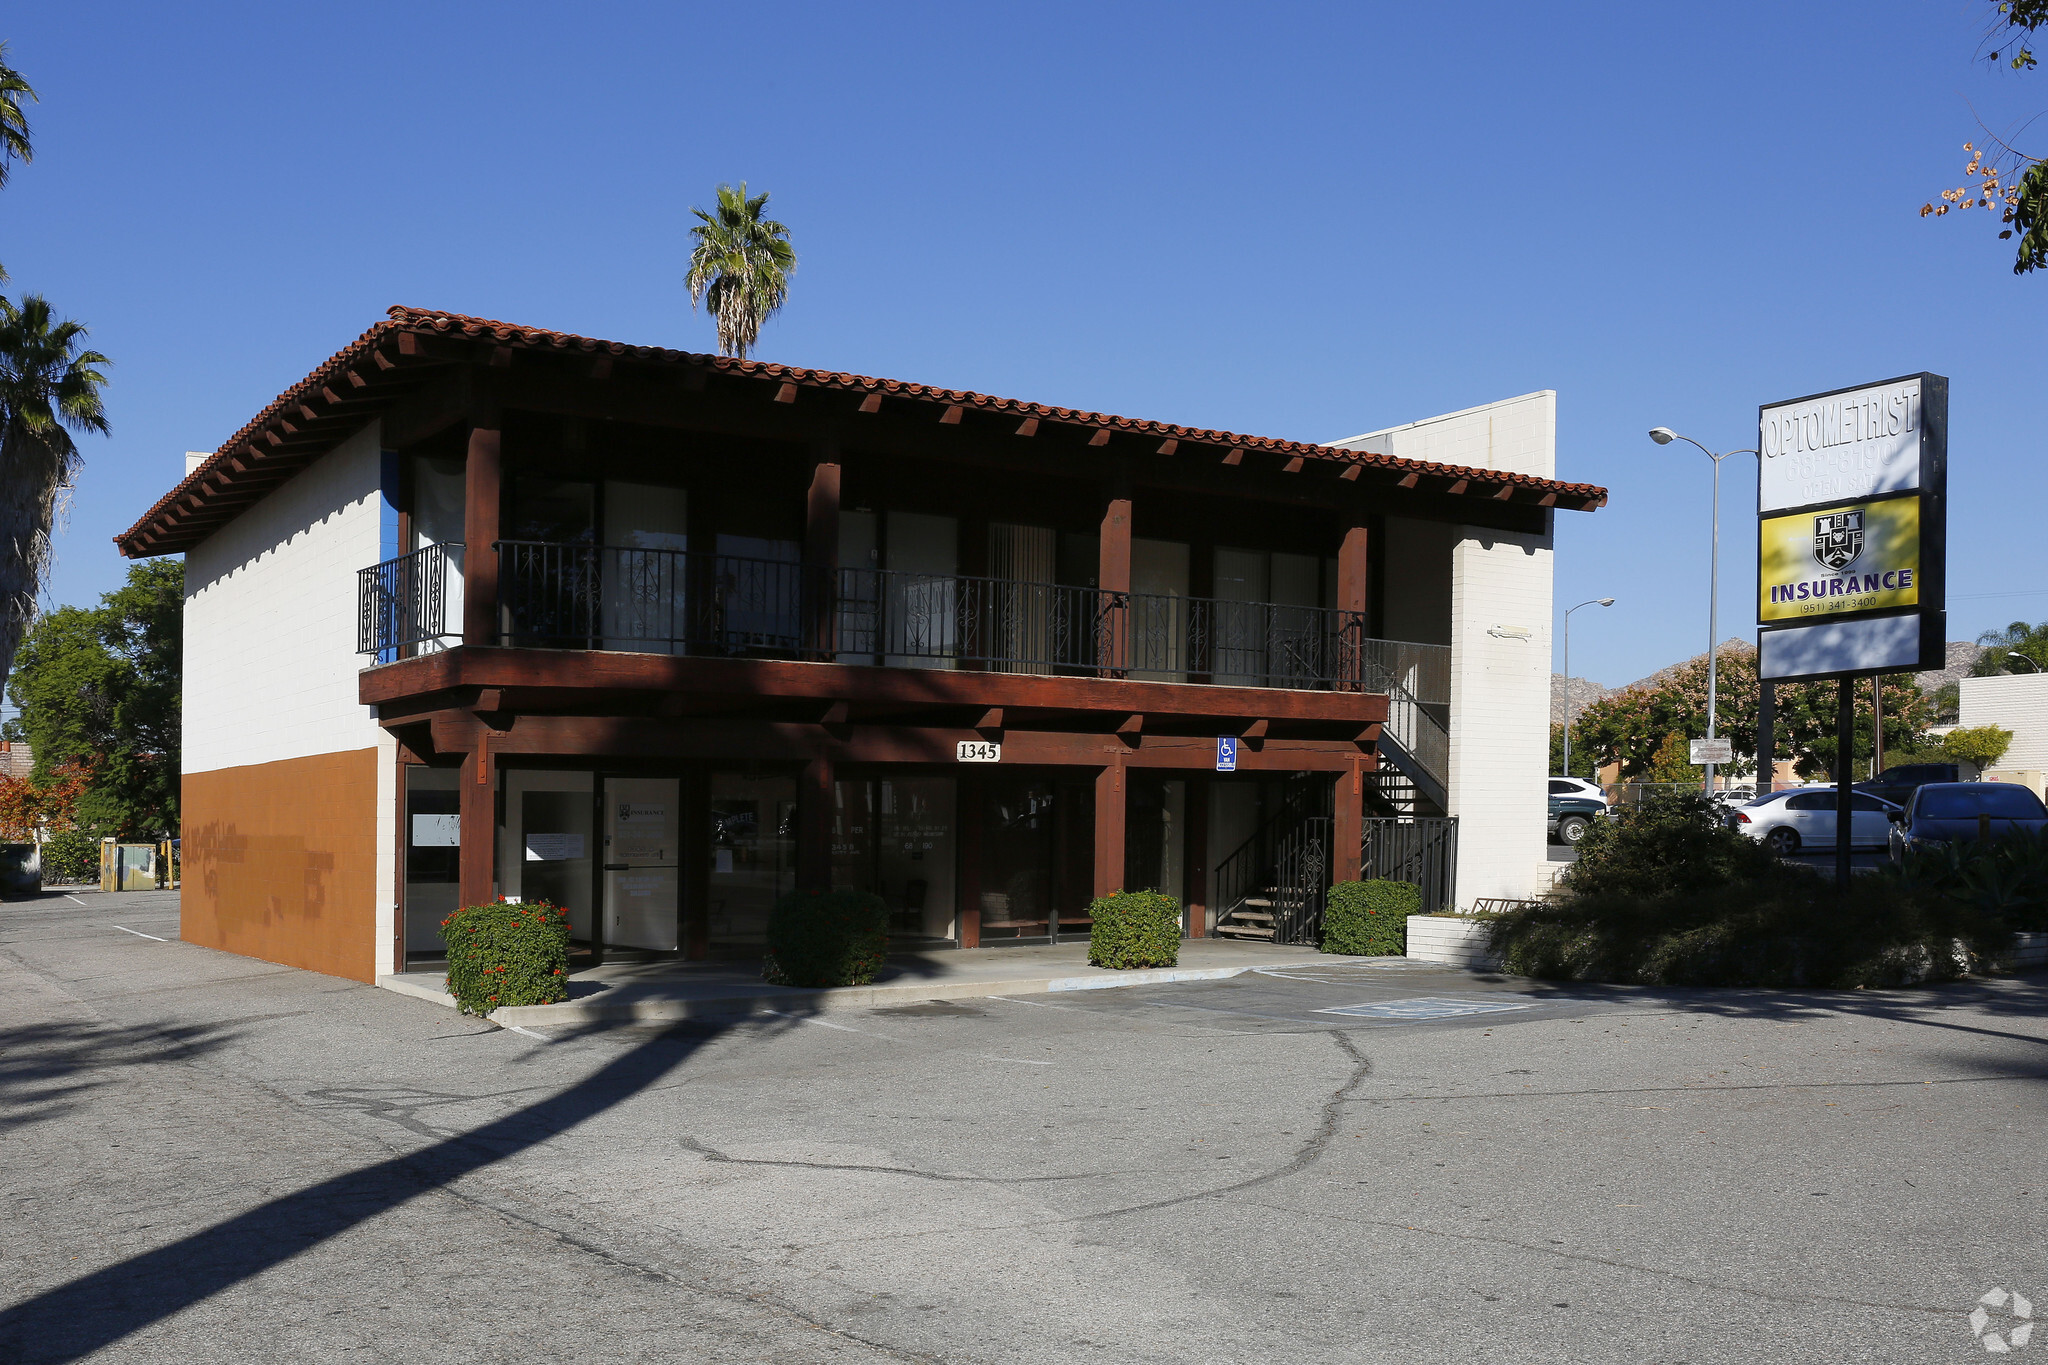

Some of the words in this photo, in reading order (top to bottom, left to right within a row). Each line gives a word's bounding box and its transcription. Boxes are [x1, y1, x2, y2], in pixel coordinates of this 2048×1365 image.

[1765, 385, 1919, 458] OPTOMETRIST
[1802, 477, 1842, 499] OPEN
[1848, 472, 1876, 492] SAT
[1770, 569, 1914, 604] INSURANCE
[1800, 603, 1825, 614] (951)
[1828, 597, 1877, 611] 341-3400
[960, 743, 997, 760] 1345
[630, 808, 665, 816] INSURANCE
